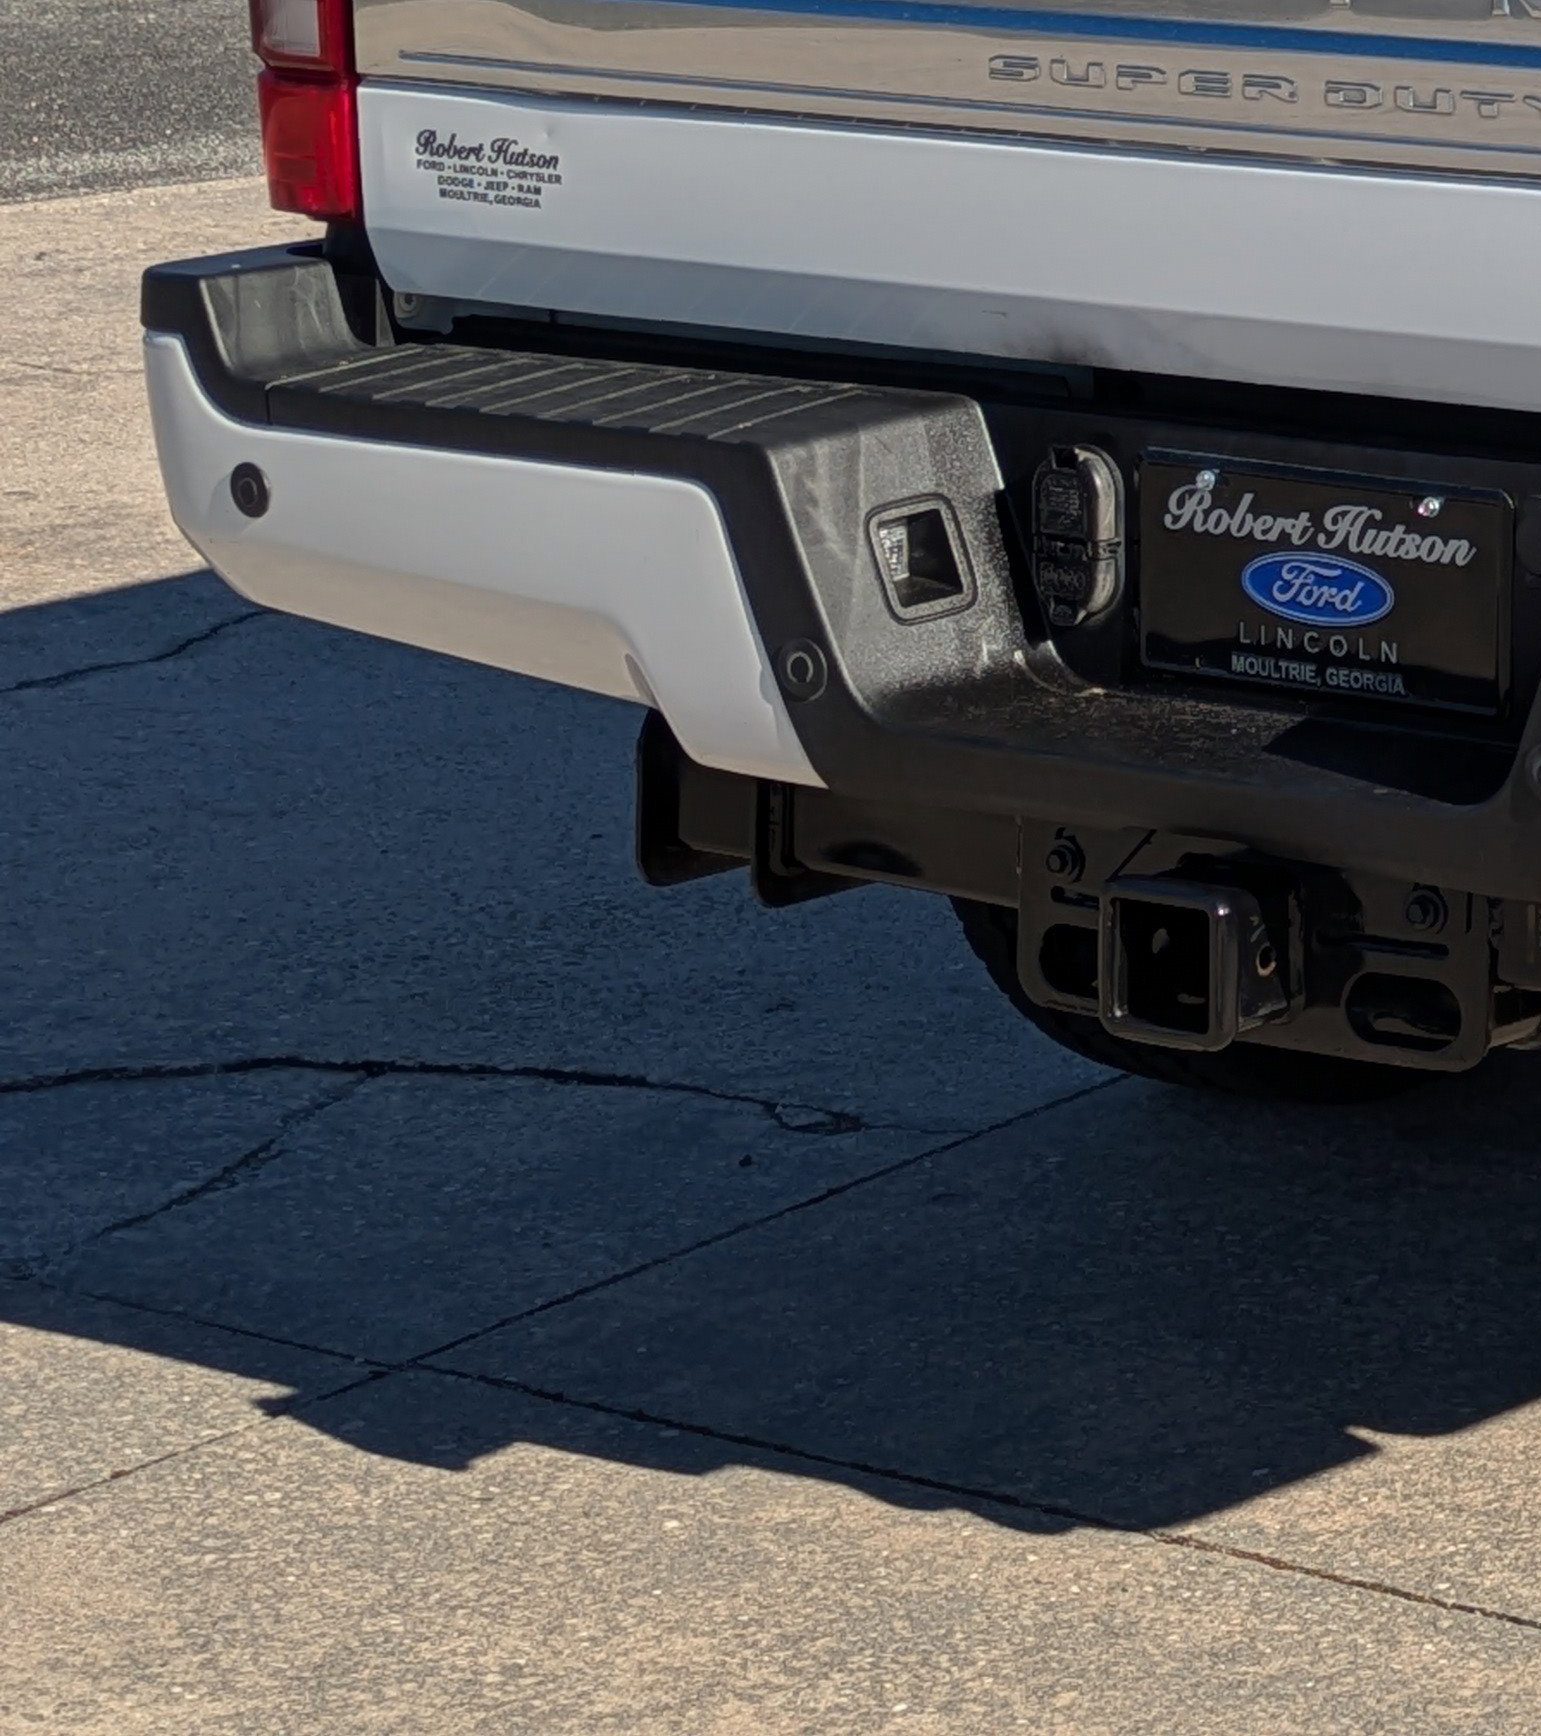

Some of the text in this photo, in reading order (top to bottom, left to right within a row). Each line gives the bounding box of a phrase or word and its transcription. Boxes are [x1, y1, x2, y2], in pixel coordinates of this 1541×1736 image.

[987, 54, 1300, 105] SUPER
[415, 128, 560, 171] Robert Hutson
[416, 159, 562, 185] FORD LINCOLN CHRYSLER
[437, 175, 542, 196] DODGE JEEP RAM
[493, 194, 542, 209] GEORGIA
[1163, 483, 1478, 566] Robert Hutson
[1271, 562, 1365, 613] Ford
[1238, 620, 1399, 665] LINCOLN
[1230, 651, 1405, 696] MOULTRIE, GEORGIA
